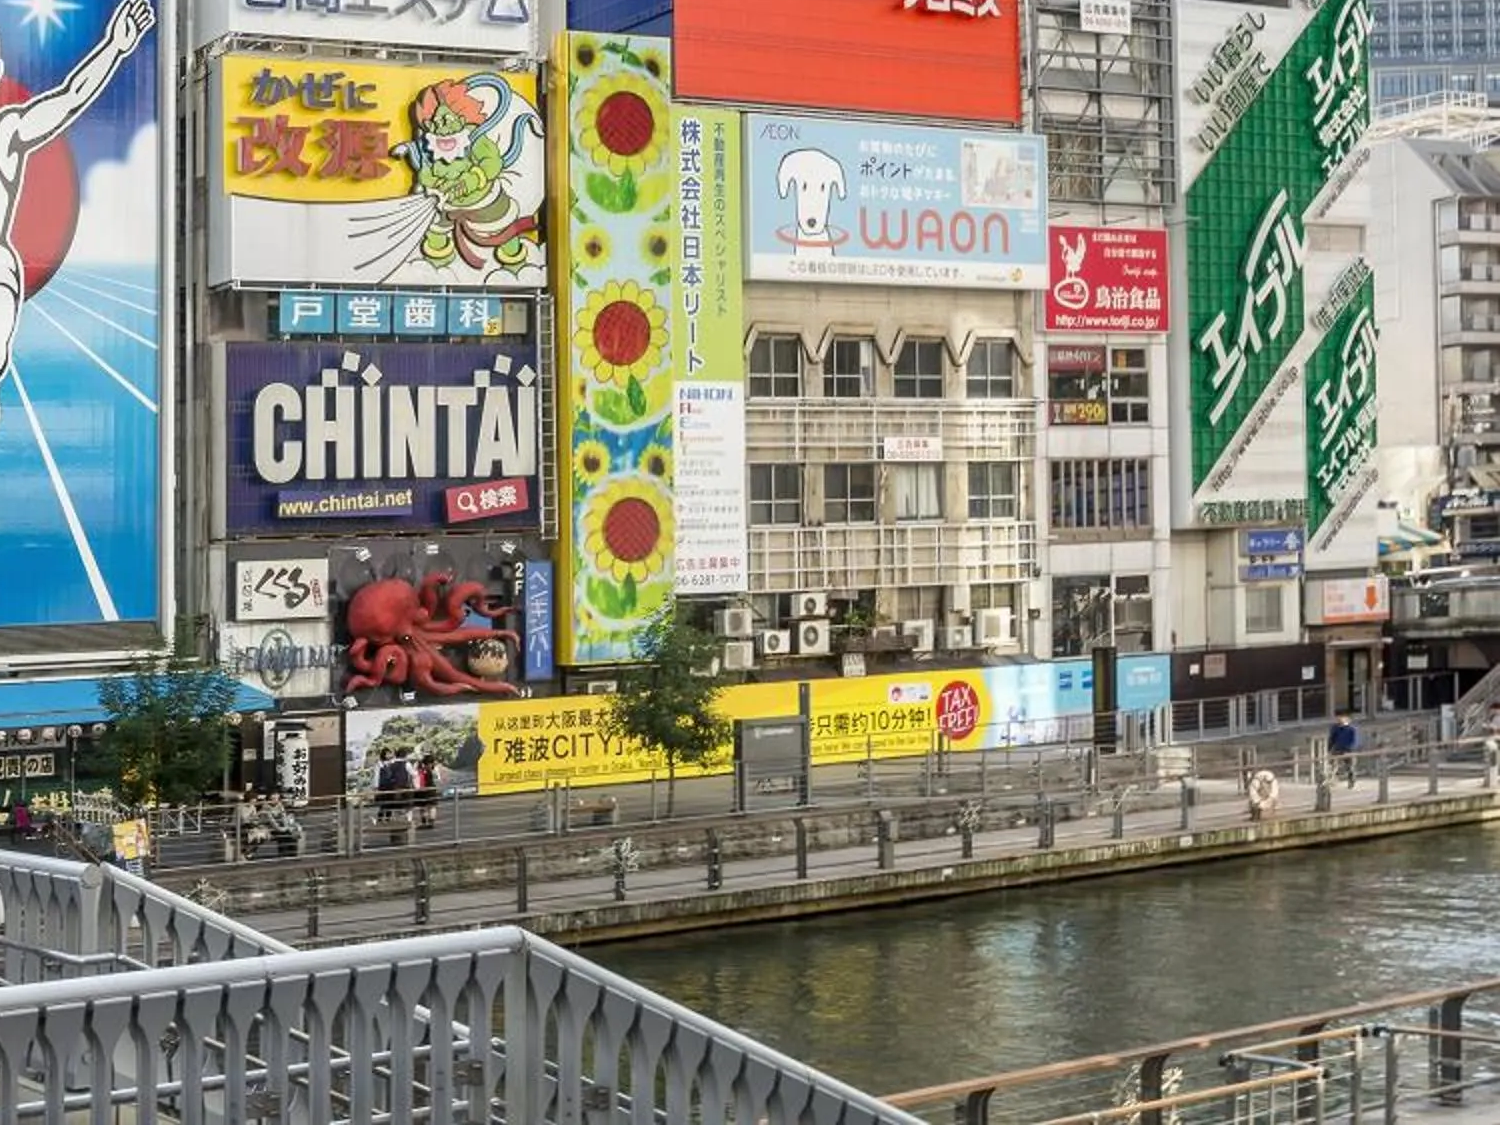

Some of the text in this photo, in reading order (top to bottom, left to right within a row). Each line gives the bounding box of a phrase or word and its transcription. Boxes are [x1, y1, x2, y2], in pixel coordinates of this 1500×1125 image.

[252, 68, 379, 112] かぜに
[229, 115, 393, 181] 改源
[680, 118, 703, 376] 株式会社日本リート
[859, 206, 1011, 255] WAON
[1200, 187, 1308, 426] エイブル
[253, 351, 537, 484] CHINTAI
[479, 485, 518, 510] 検索
[941, 685, 972, 713] TAX
